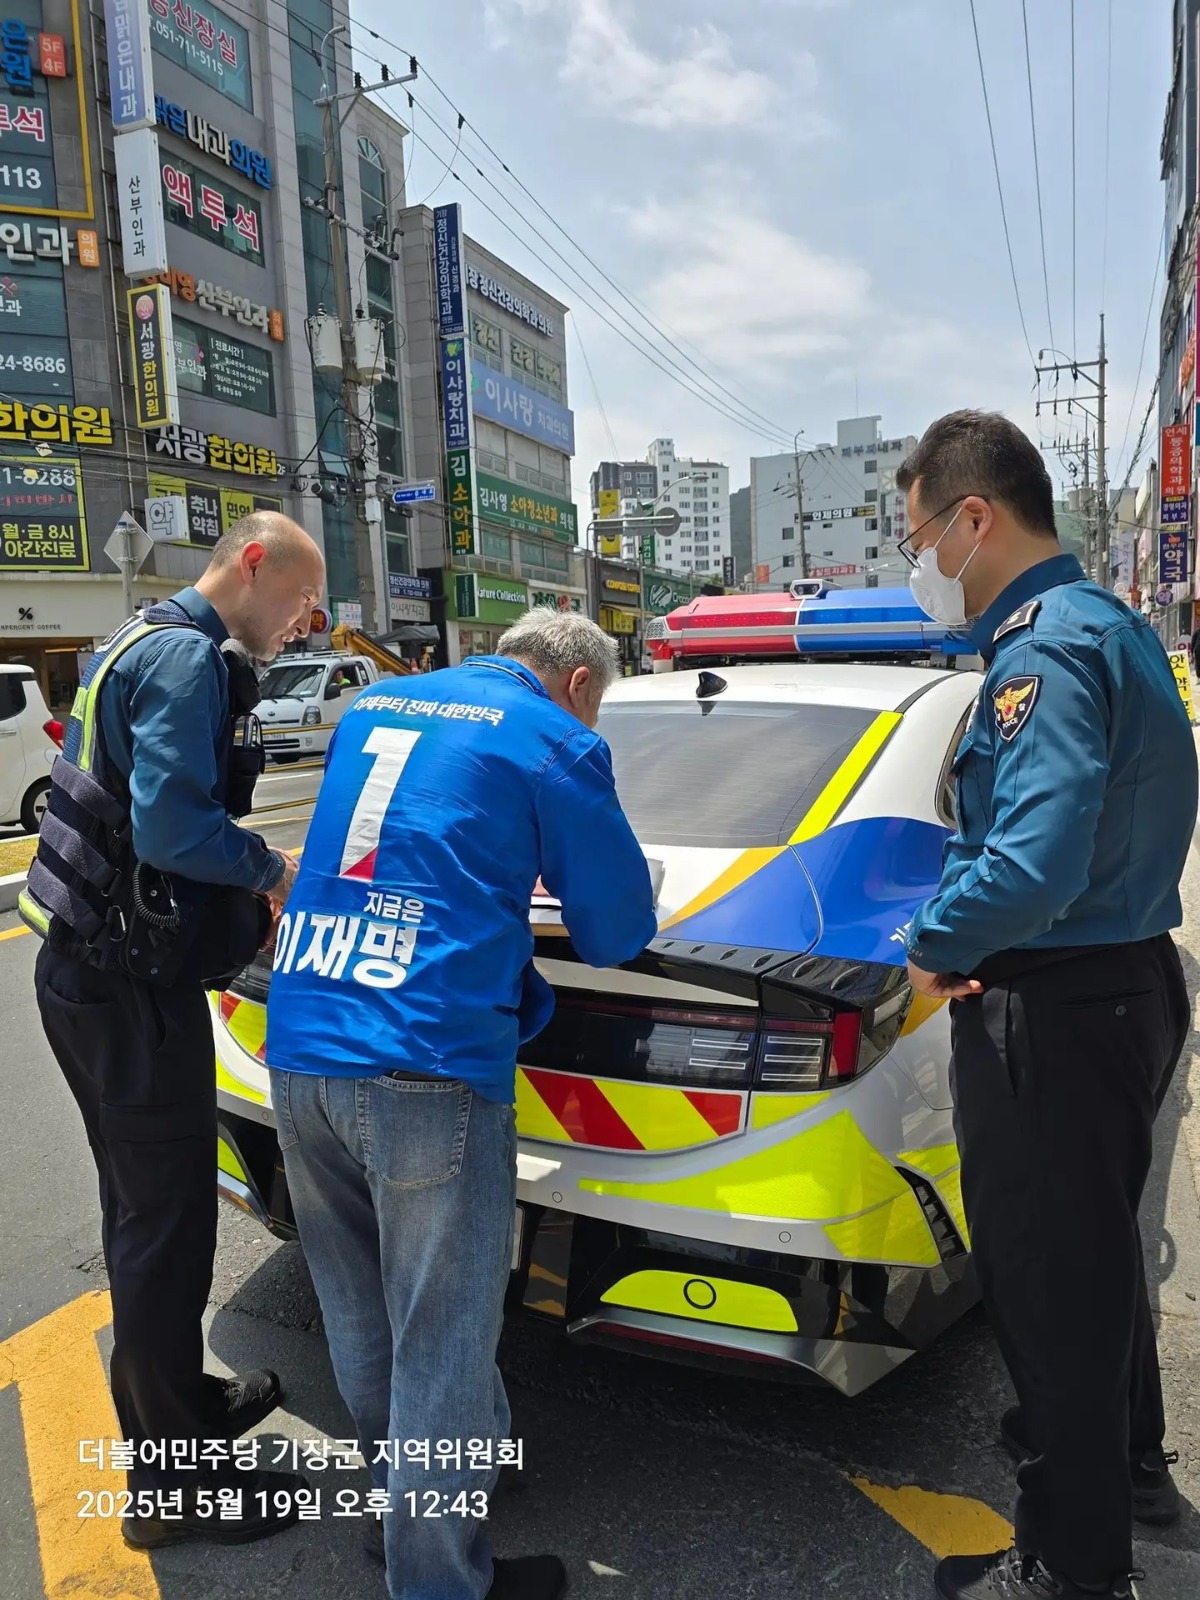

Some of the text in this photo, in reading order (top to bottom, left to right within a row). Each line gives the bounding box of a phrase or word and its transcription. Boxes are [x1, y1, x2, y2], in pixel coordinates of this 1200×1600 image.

[42, 38, 61, 52] 5F
[43, 58, 63, 72] 4F
[0, 165, 42, 189] 113
[128, 176, 146, 257] 산부인과
[162, 164, 260, 252] 액투석
[0, 222, 74, 266] 인과
[81, 233, 96, 263] 의원
[437, 218, 452, 315] 정신건강의학과
[140, 322, 160, 417] 서광한의원
[175, 356, 208, 381] 부인과
[446, 361, 466, 438] 이사랑치과
[485, 378, 534, 427] 이사랑
[0, 401, 113, 444] 한의원
[150, 501, 174, 536] 약
[190, 495, 218, 517] 추나
[450, 455, 471, 549] 김소아과
[511, 495, 558, 527] 소아청소년과
[2, 523, 75, 540] 월·금 8시
[191, 516, 220, 538] 약침
[4, 540, 77, 558] 야간진료
[1164, 549, 1184, 582] 약국
[496, 589, 526, 603] Collection
[353, 695, 505, 727] 이제부터 진짜 대한민국
[339, 726, 423, 883] 1
[363, 891, 425, 924] 지금은
[272, 911, 419, 990] 이재명
